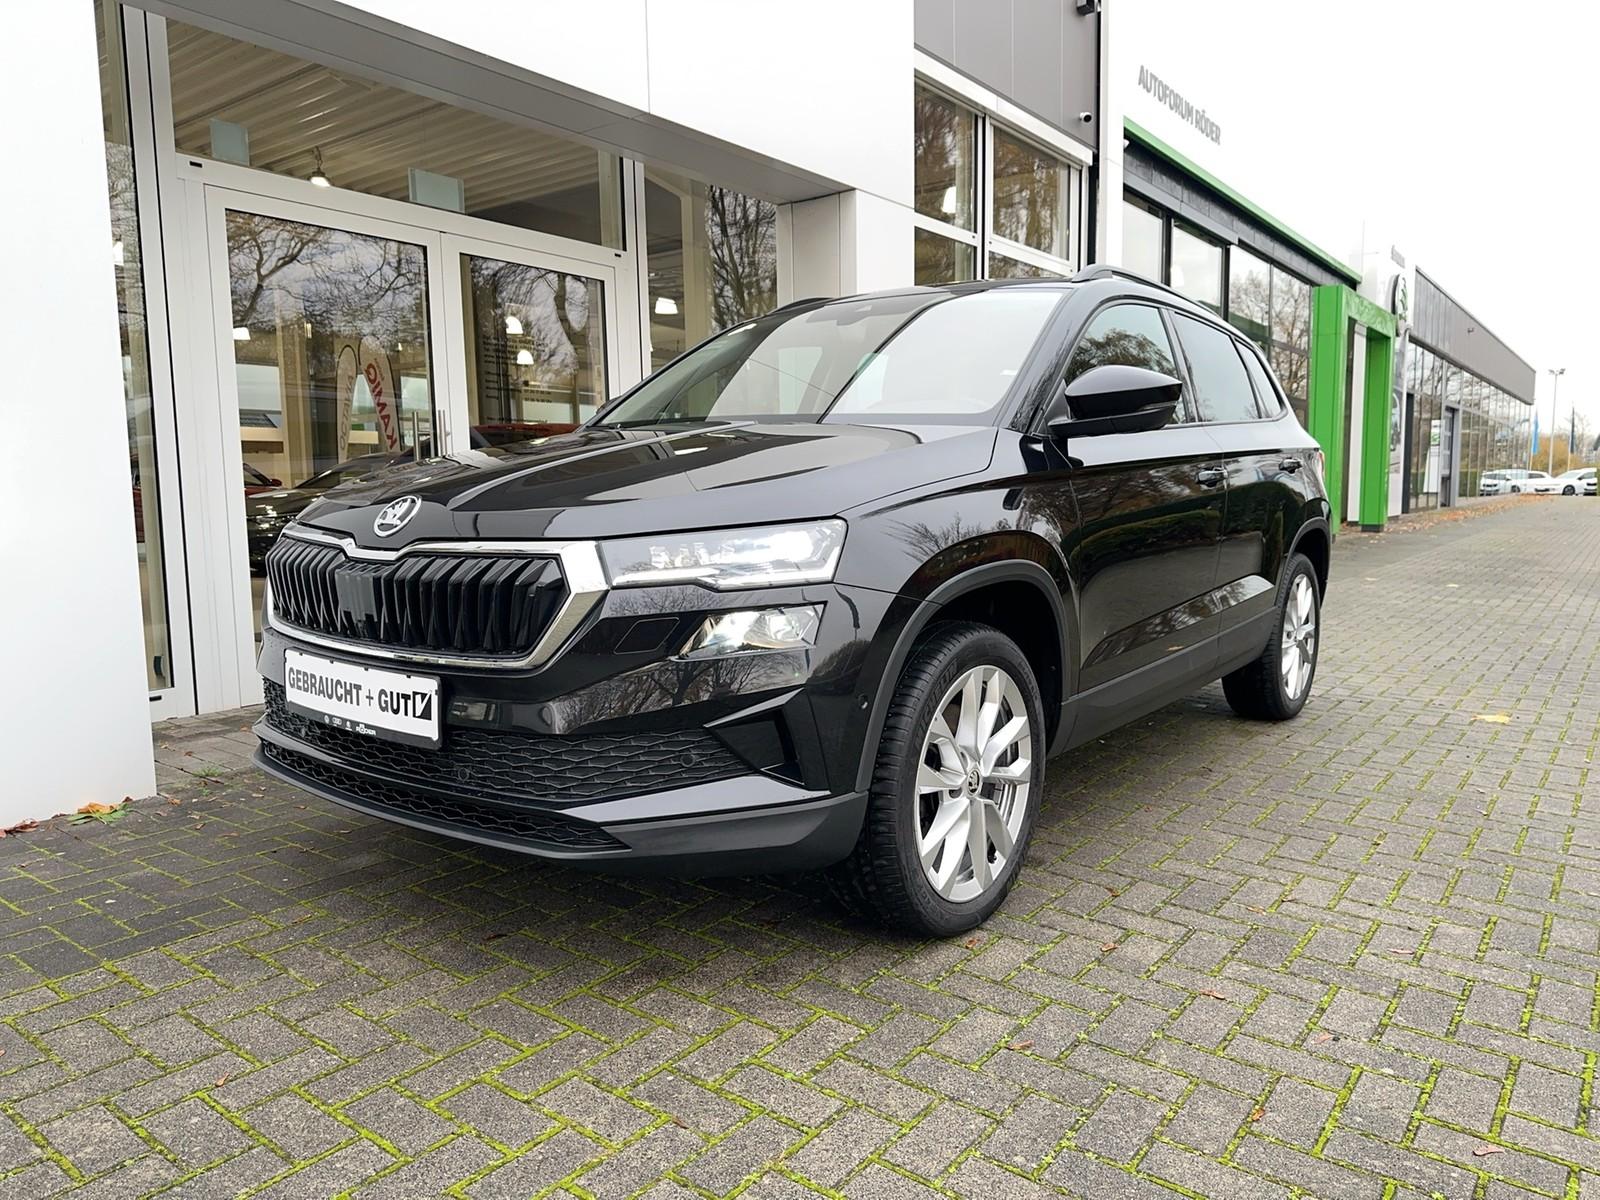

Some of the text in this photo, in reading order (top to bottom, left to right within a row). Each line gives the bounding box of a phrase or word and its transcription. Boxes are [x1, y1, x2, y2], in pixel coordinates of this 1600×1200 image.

[1138, 64, 1221, 146] AUTOFORUM RÖDER
[288, 666, 412, 717] GEBRAUCHT + GUT
